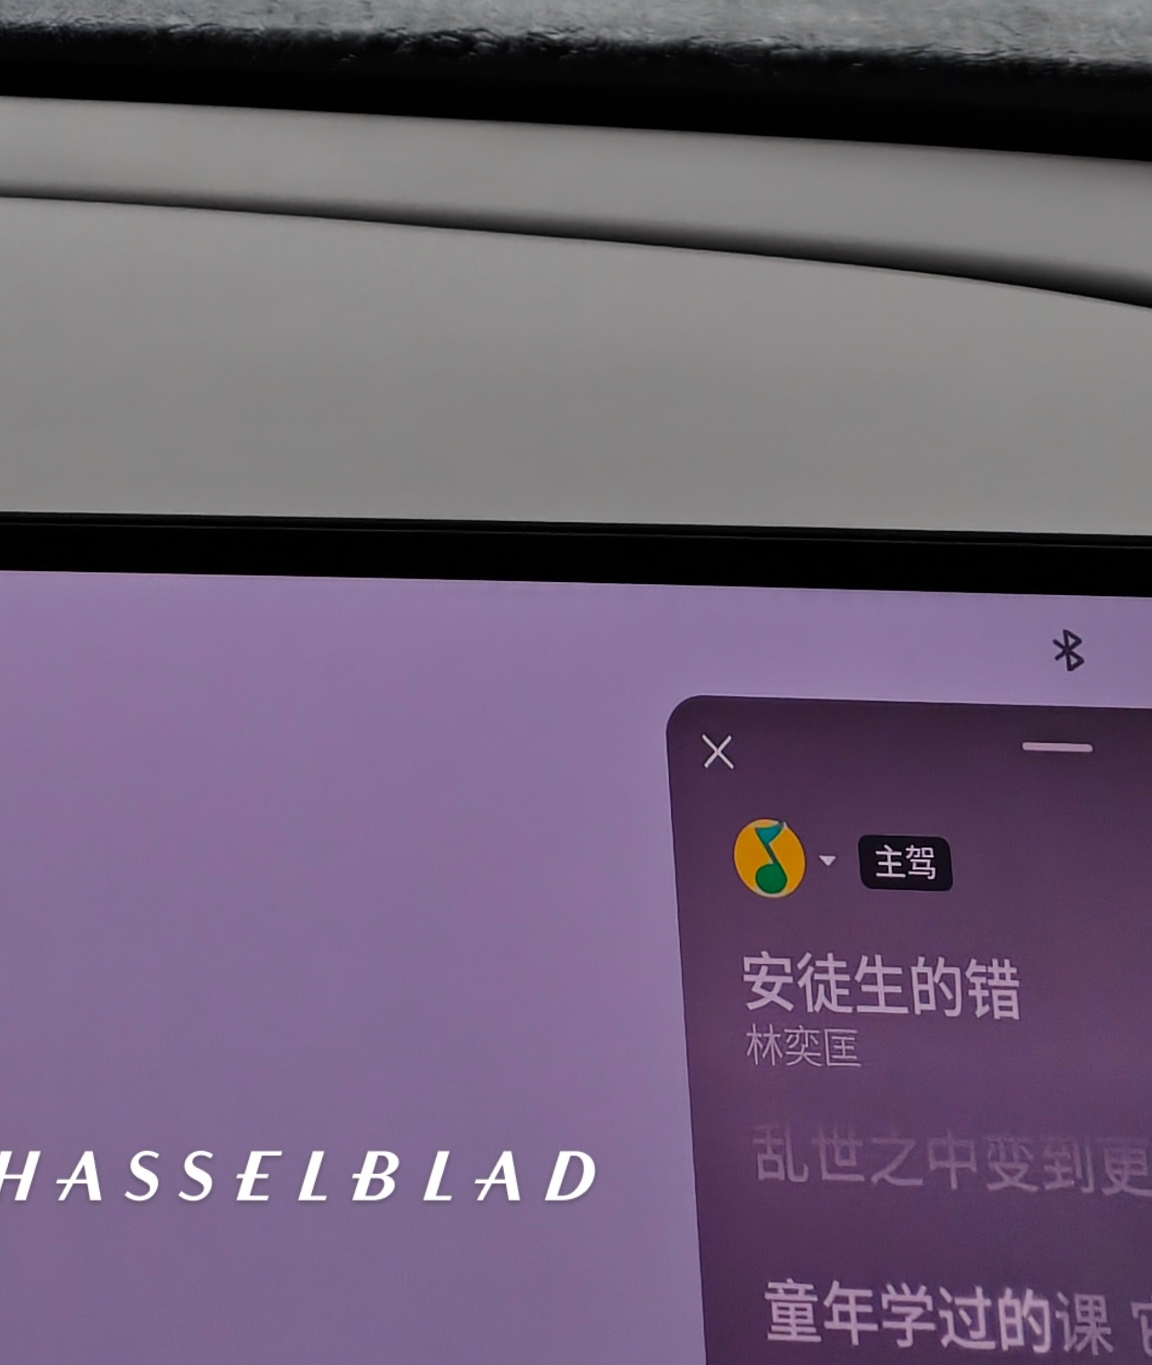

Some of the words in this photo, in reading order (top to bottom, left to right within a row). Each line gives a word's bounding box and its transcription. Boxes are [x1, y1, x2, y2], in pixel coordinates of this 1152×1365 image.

[875, 845, 937, 881] 主驾
[742, 951, 1021, 1021] 安徒生的错
[746, 1023, 862, 1067] 林奕匡
[765, 1277, 1115, 1357] 童年学过的课
